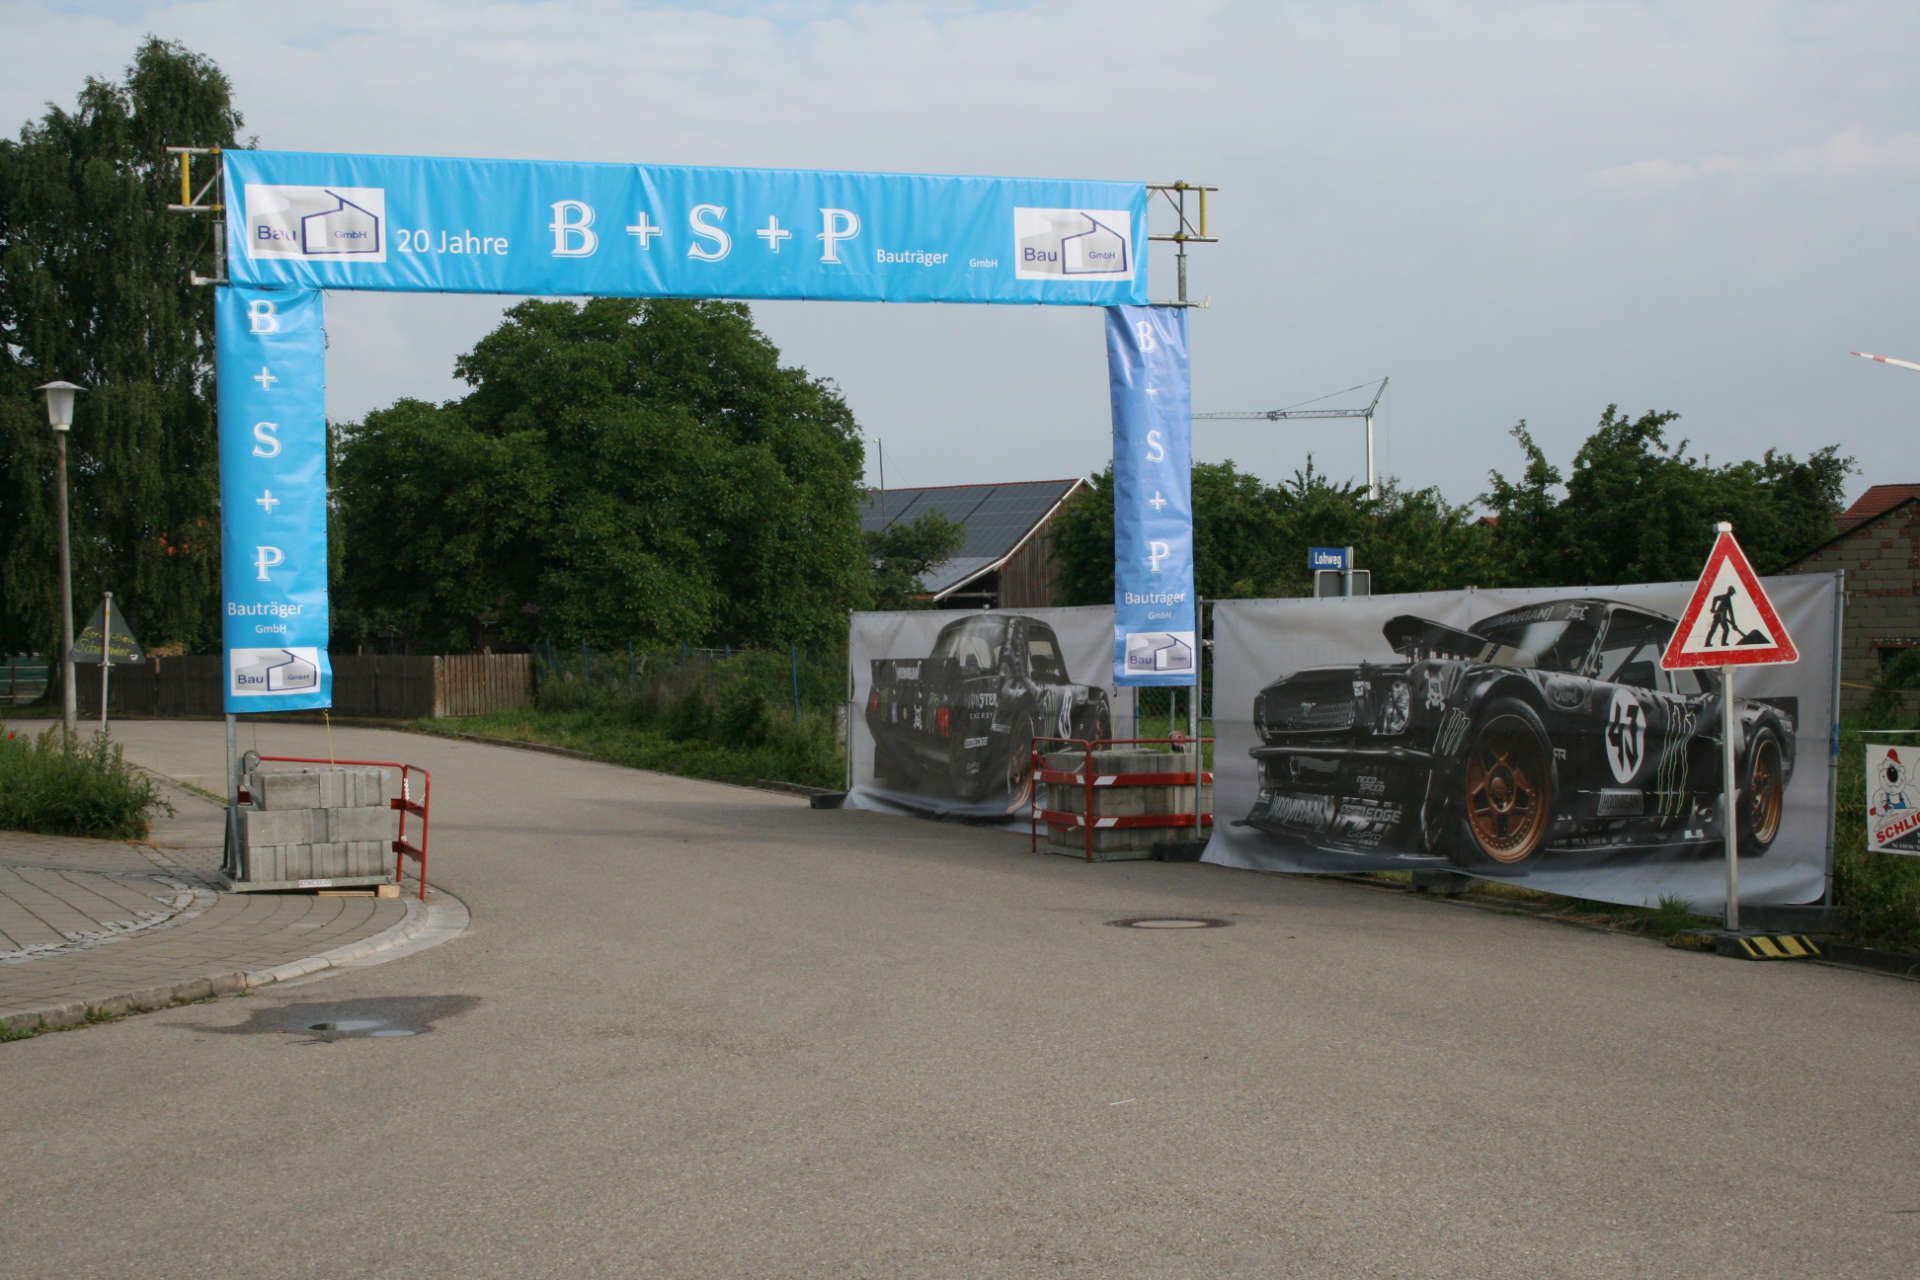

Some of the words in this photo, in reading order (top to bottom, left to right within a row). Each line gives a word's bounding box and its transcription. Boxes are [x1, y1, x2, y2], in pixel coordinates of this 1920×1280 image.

[257, 225, 297, 241] Bau
[334, 230, 368, 239] GmbH
[398, 229, 430, 253] 20
[437, 230, 510, 255] Jahre
[548, 199, 598, 258] B
[625, 211, 663, 252] +
[686, 204, 732, 263] S
[756, 215, 792, 254] +
[817, 207, 860, 265] P
[876, 249, 949, 269] Bauträger
[968, 257, 999, 269] GmbH
[1023, 247, 1058, 262] Bau
[1088, 250, 1116, 260] GmbH
[247, 300, 281, 335] B
[1135, 320, 1155, 353] B
[254, 367, 278, 391] +
[252, 422, 282, 458] S
[1145, 430, 1165, 463] S
[256, 489, 280, 513] +
[1149, 491, 1166, 512] +
[254, 546, 285, 582] P
[1147, 541, 1171, 573] P
[227, 602, 304, 618] Bauträger
[1125, 592, 1186, 607] Bauträger
[255, 624, 287, 635] GmbH
[1128, 656, 1153, 666] Bau
[237, 674, 265, 685] Bau
